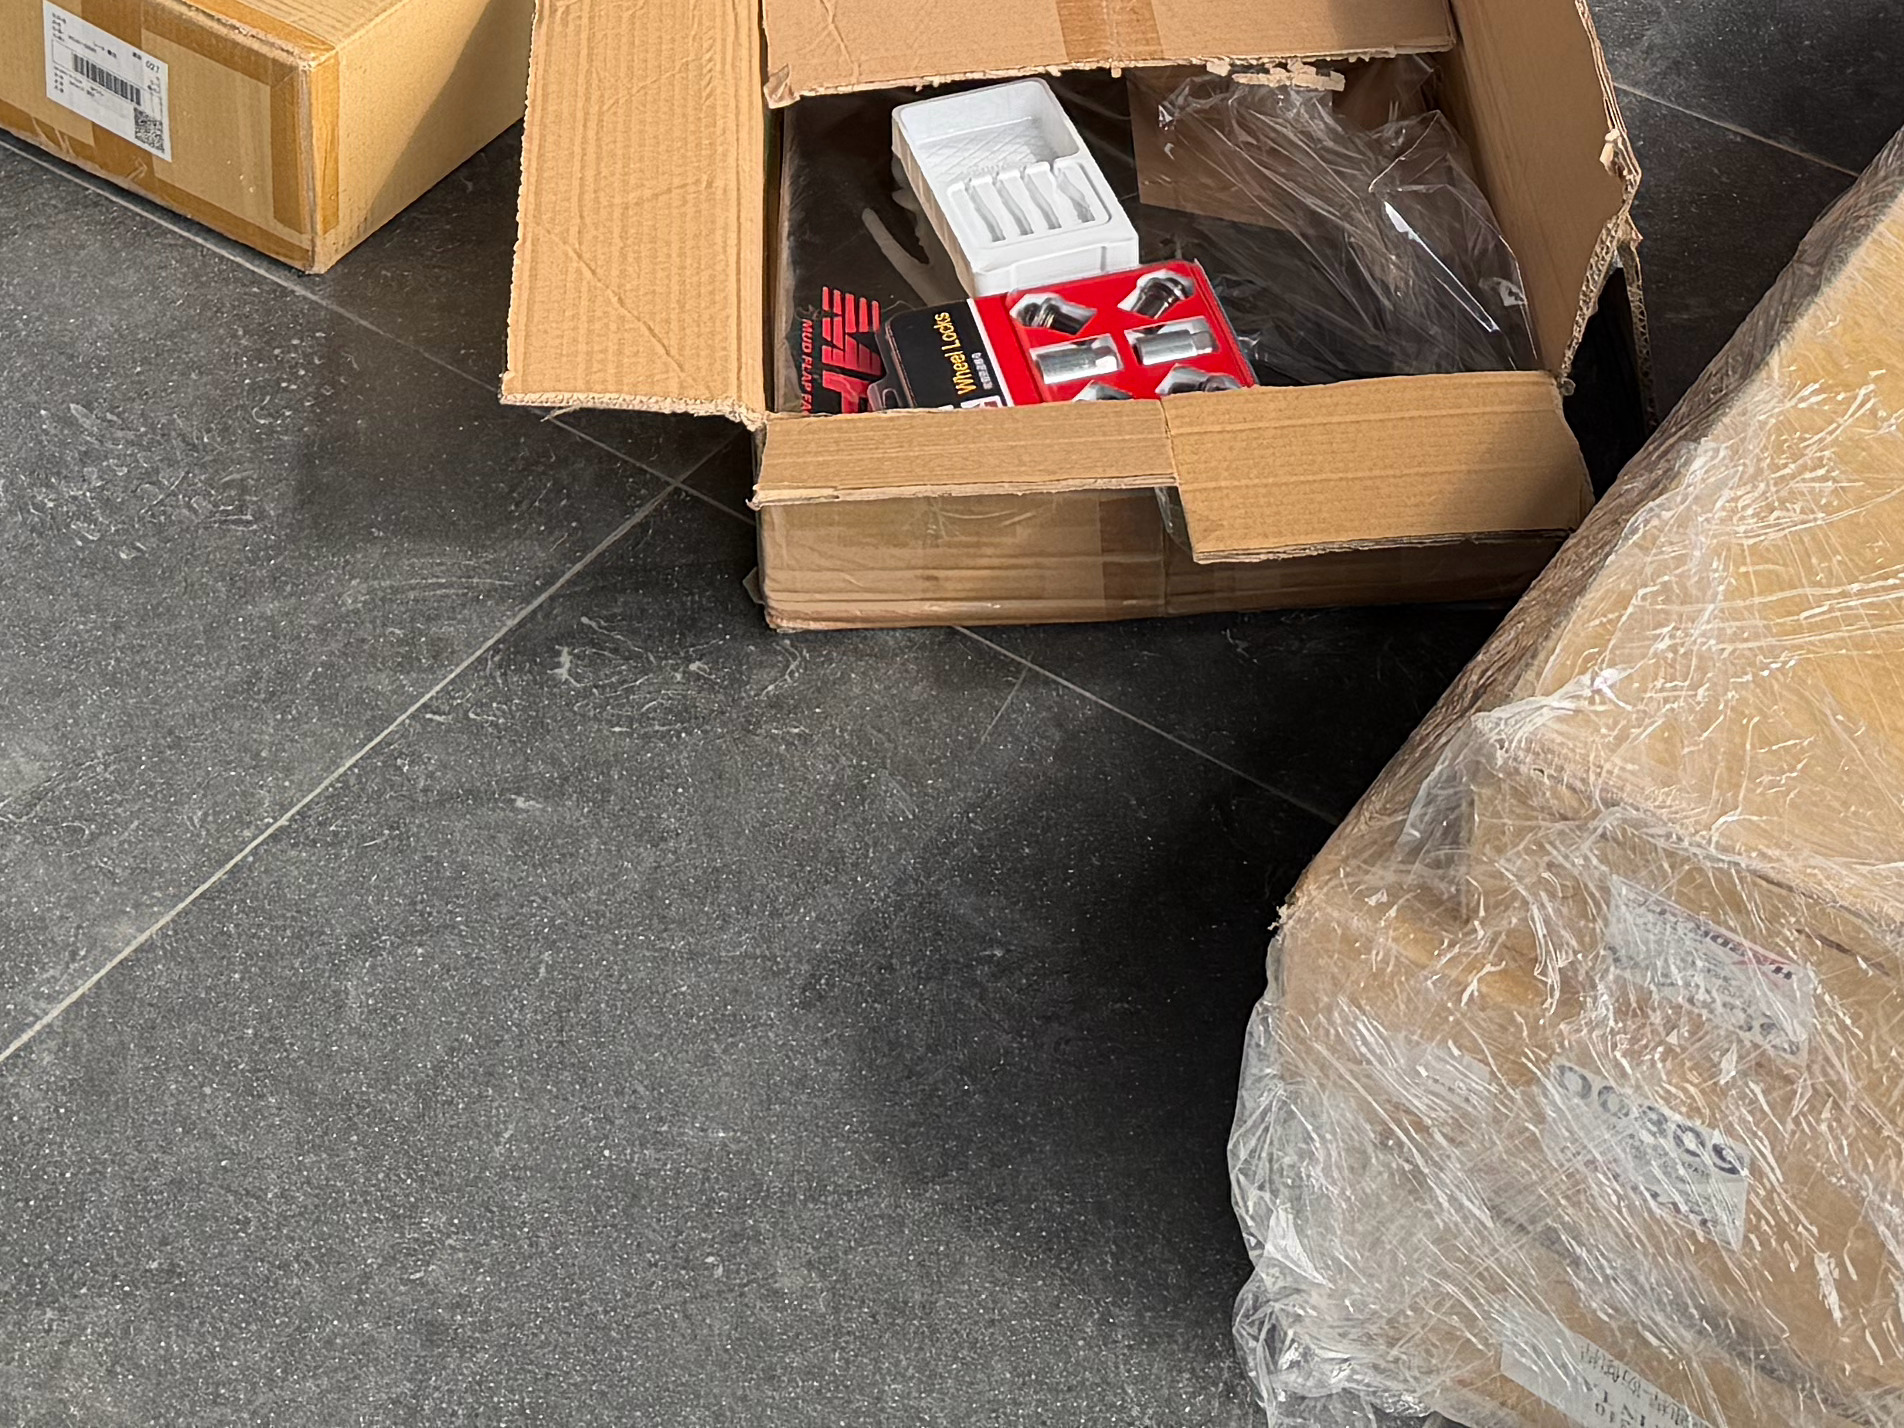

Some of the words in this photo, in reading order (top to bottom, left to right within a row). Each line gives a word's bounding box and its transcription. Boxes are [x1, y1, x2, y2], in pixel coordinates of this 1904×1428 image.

[801, 318, 813, 352] MUD
[934, 311, 955, 351] Locks
[800, 355, 812, 391] FLAP
[950, 352, 977, 395] Wheel
